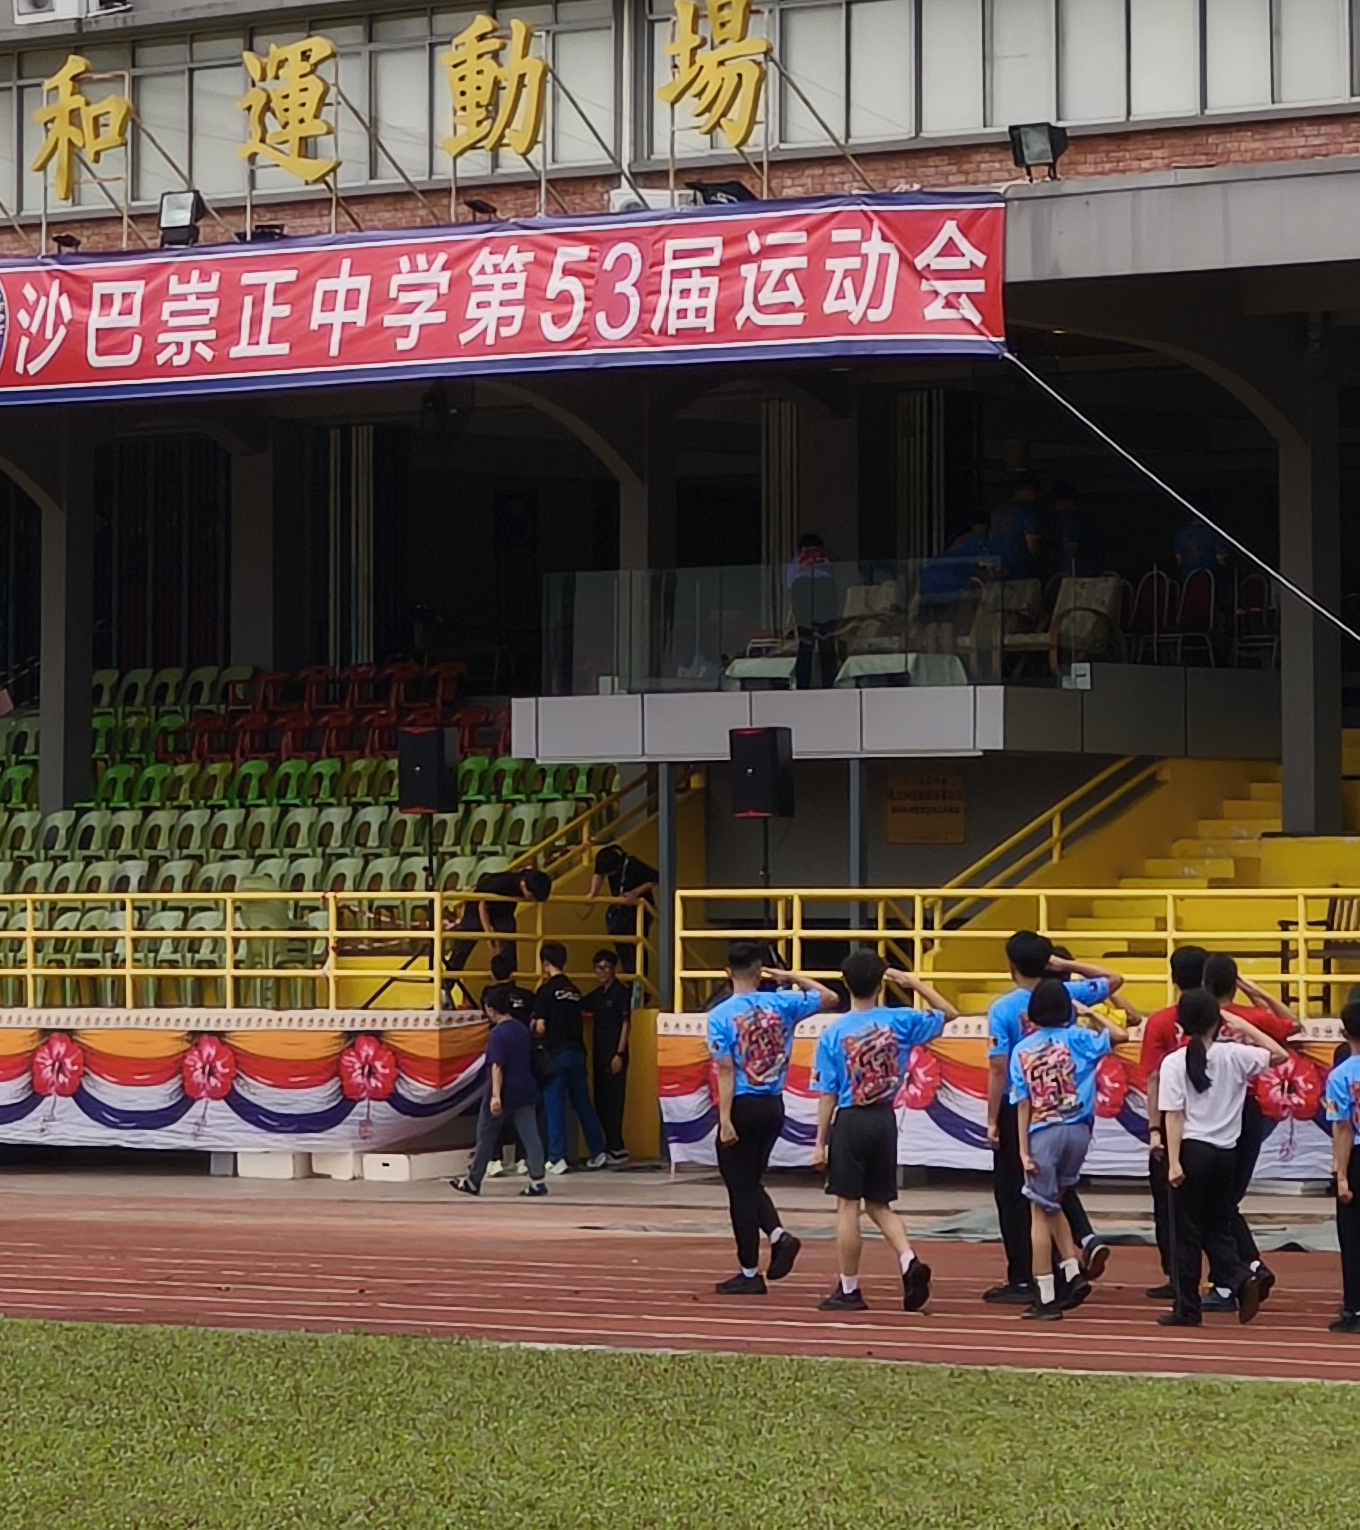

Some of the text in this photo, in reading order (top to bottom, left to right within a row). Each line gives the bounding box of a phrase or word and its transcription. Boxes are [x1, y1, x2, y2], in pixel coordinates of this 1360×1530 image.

[15, 218, 987, 376] 沙巴崇正中学第53届运动会
